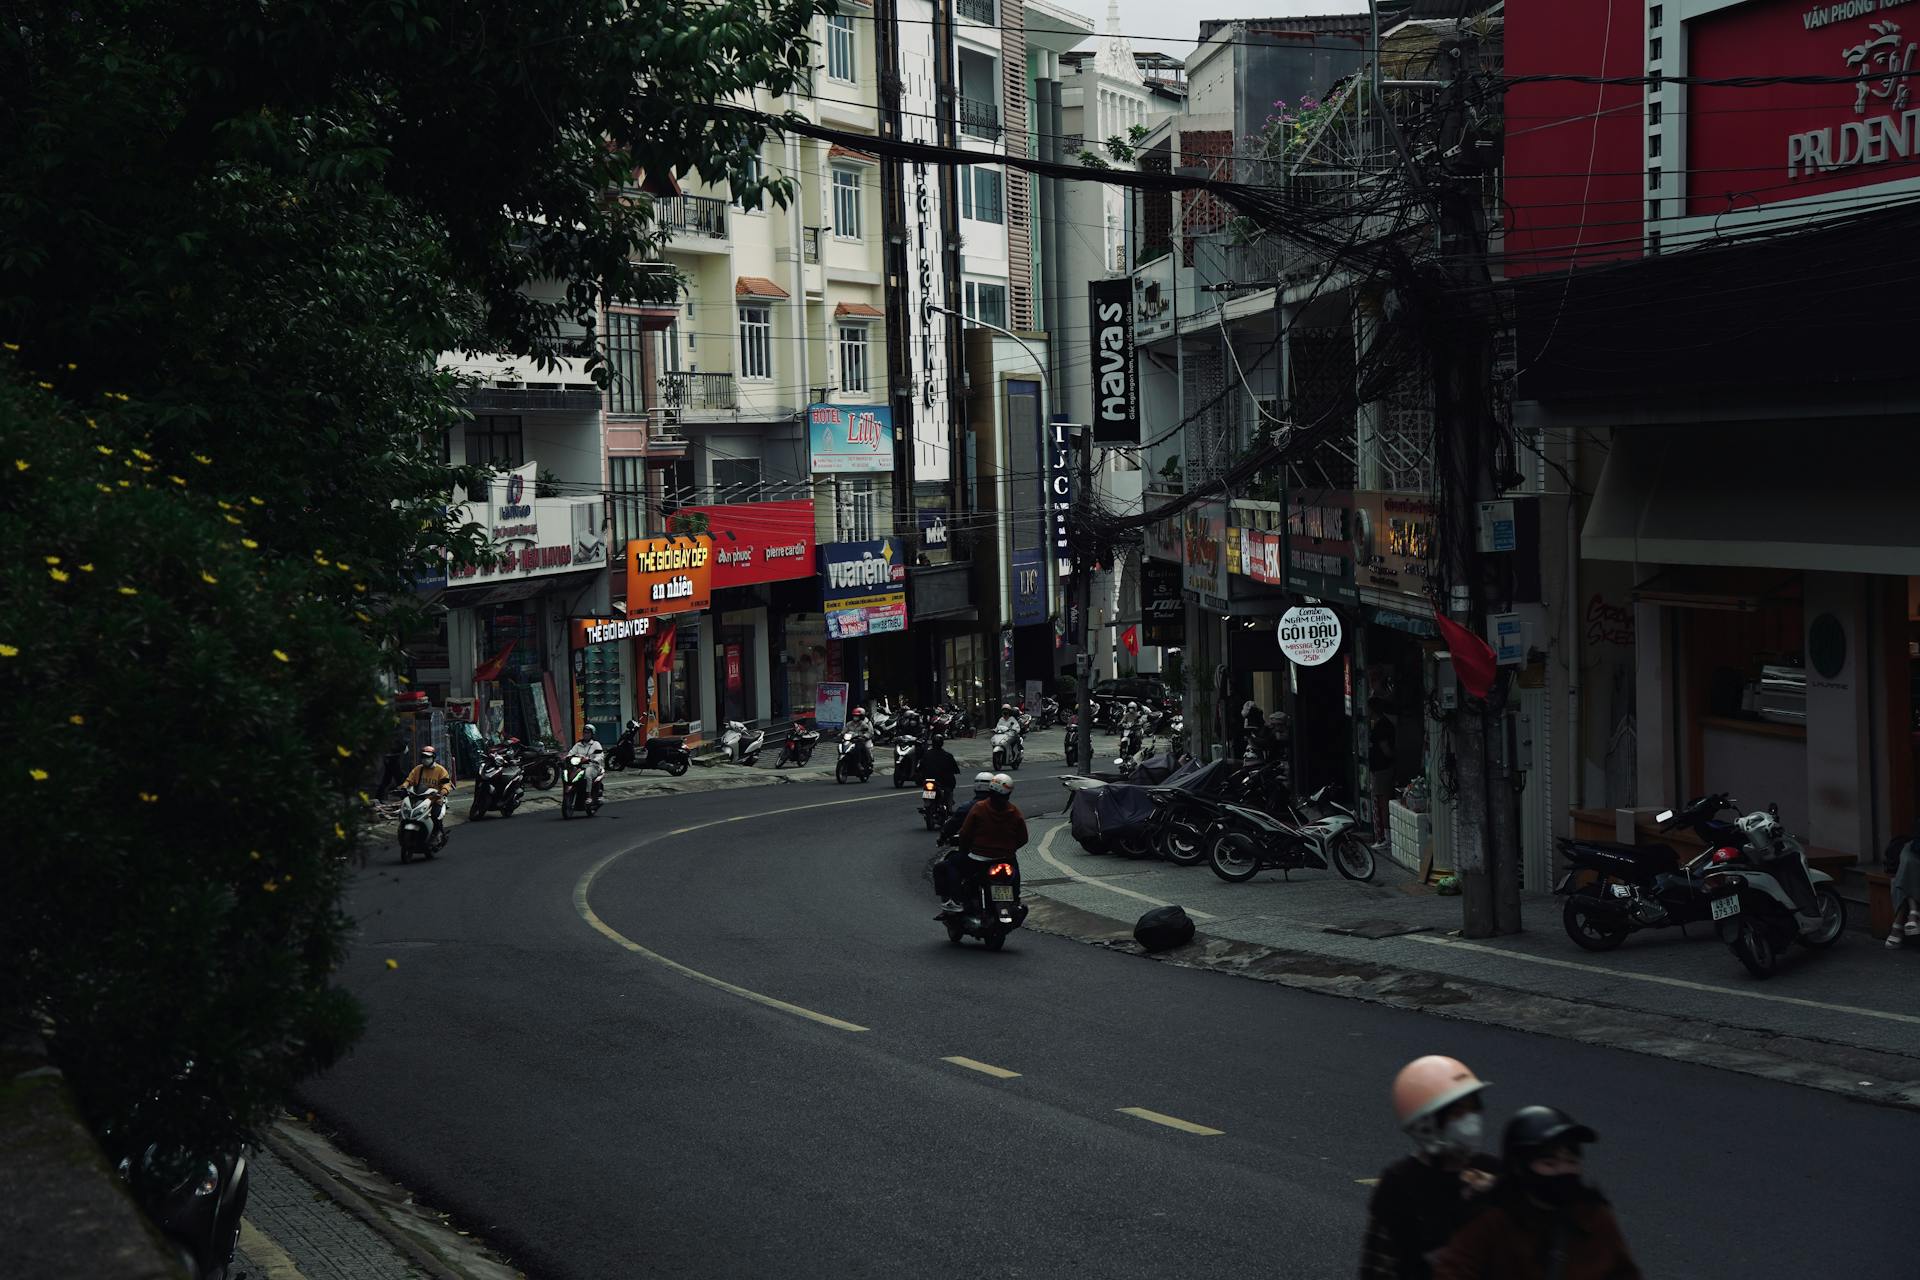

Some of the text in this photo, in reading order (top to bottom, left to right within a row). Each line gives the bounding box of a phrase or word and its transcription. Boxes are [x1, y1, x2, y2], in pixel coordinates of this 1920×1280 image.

[1802, 5, 1830, 30] VĂN
[812, 407, 841, 425] HOTEL
[847, 411, 882, 452] Lilly
[637, 542, 708, 573] THẾ GIỚI GIÀY DÉP
[764, 543, 805, 561] pierre cardin
[1264, 543, 1280, 578] 95K
[652, 575, 694, 601] an nhiên
[1284, 613, 1332, 624] NGÂM CHÂN
[1298, 608, 1323, 616] Combo
[1281, 621, 1338, 642] GỘI ĐẦU
[1285, 638, 1336, 650] MASSAGE 95K
